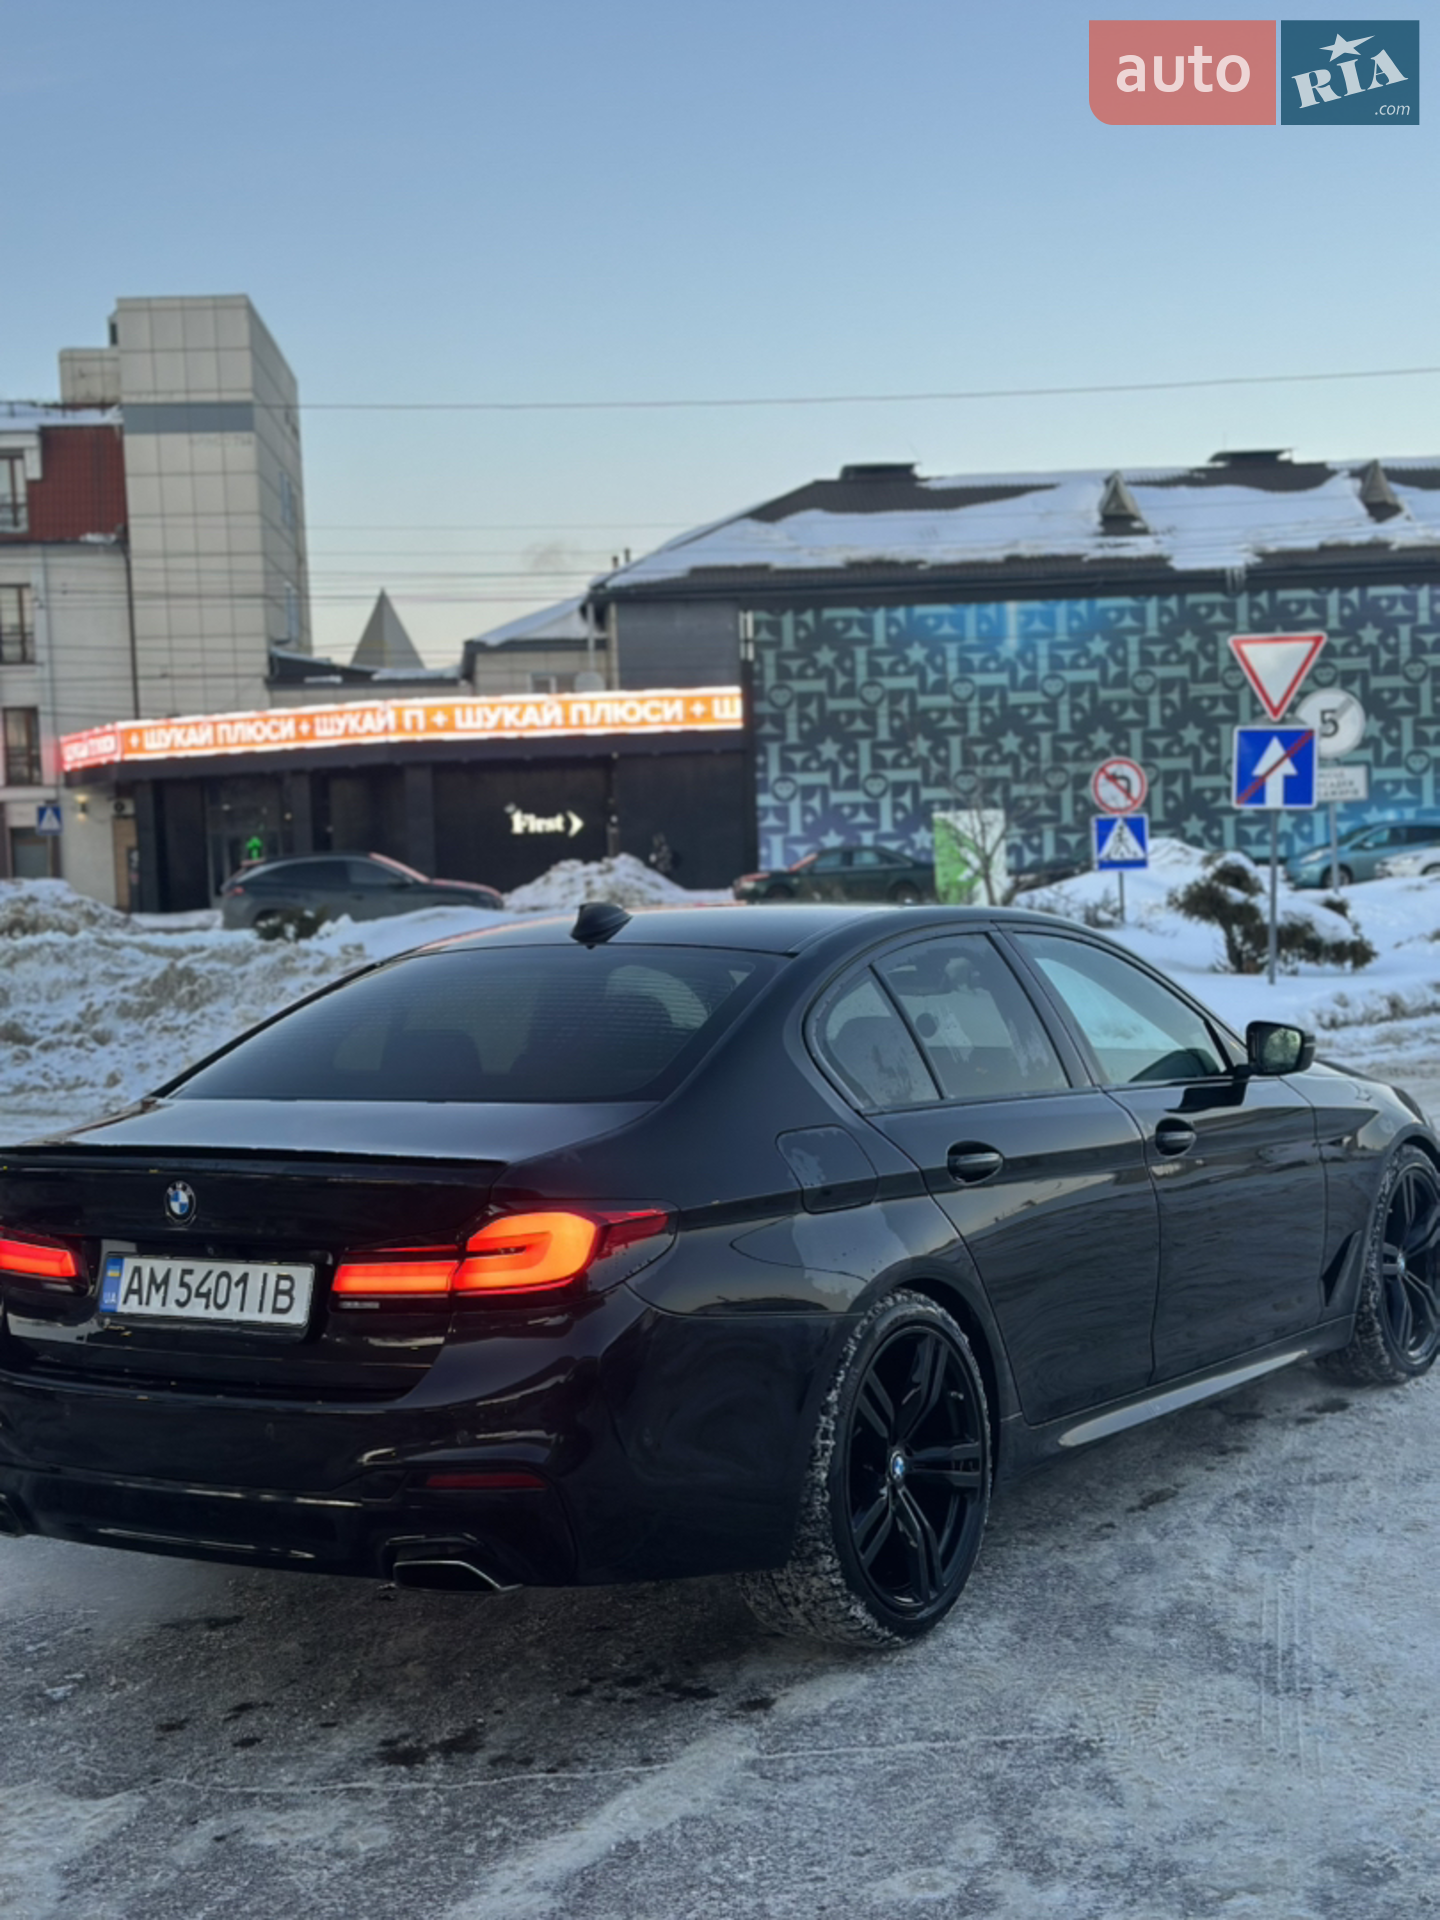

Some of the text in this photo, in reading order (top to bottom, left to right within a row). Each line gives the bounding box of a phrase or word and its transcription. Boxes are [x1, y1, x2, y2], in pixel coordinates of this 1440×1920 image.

[145, 722, 214, 751] ШУКАЙ
[217, 718, 295, 746] ПЛЮСИ
[314, 704, 396, 738] ШУКАЙ
[454, 701, 564, 730] ШУКАЙ
[570, 699, 684, 726] ПЛЮСИ
[1320, 709, 1339, 738] 5
[511, 809, 565, 834] First
